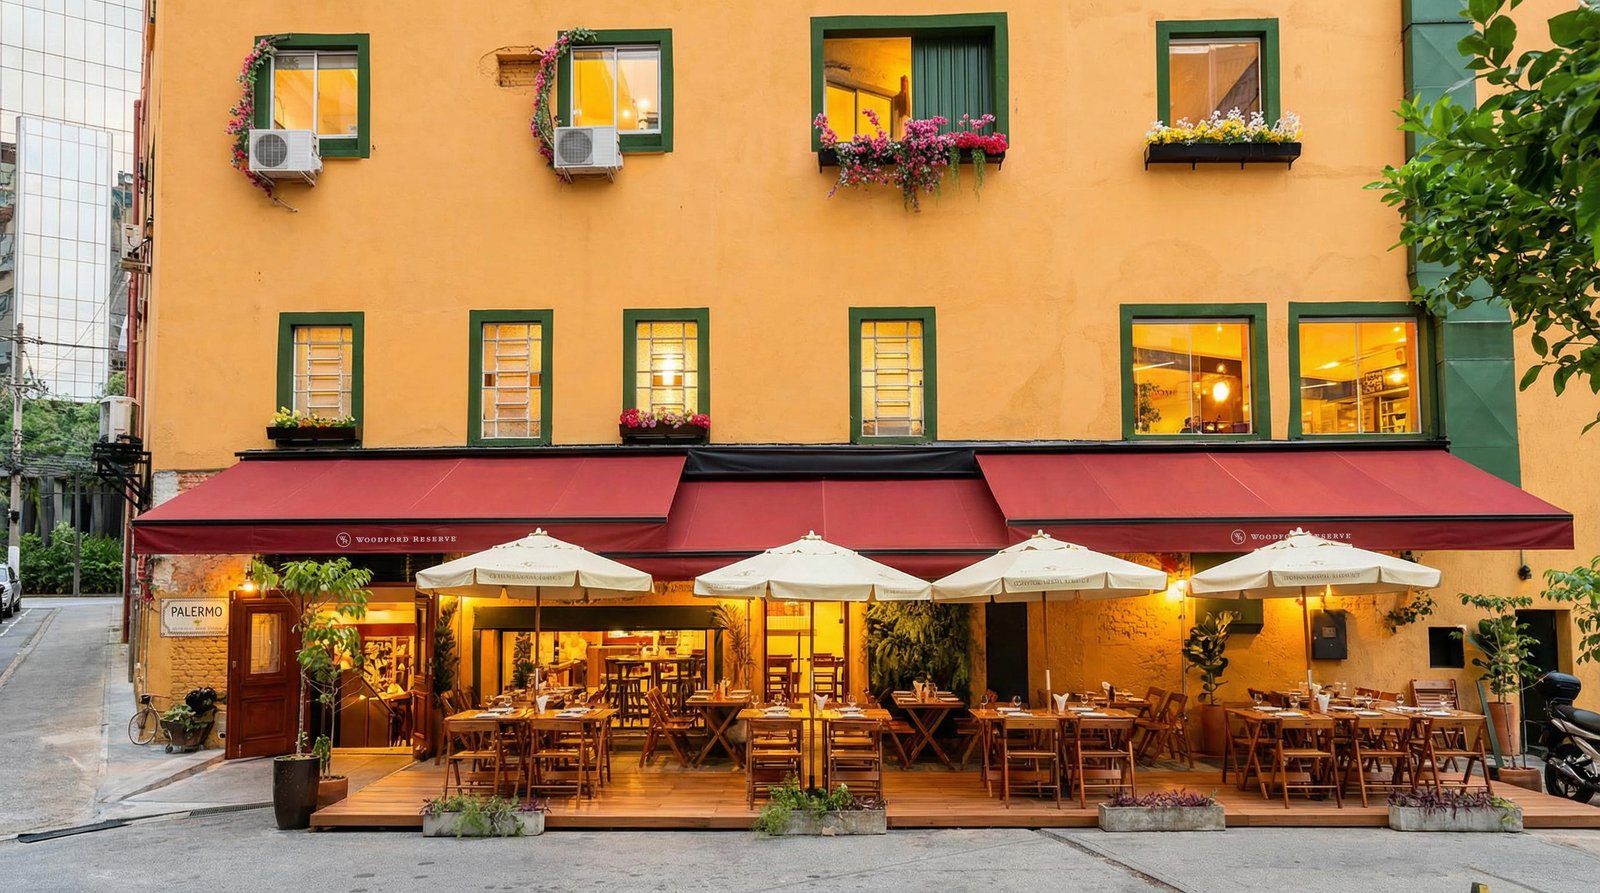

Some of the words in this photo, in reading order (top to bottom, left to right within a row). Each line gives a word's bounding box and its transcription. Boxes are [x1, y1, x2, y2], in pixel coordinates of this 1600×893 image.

[355, 536, 409, 544] WOODFORD
[413, 535, 457, 543] RESERVE
[1250, 533, 1290, 541] WOODFO
[171, 606, 223, 617] PALERMO
